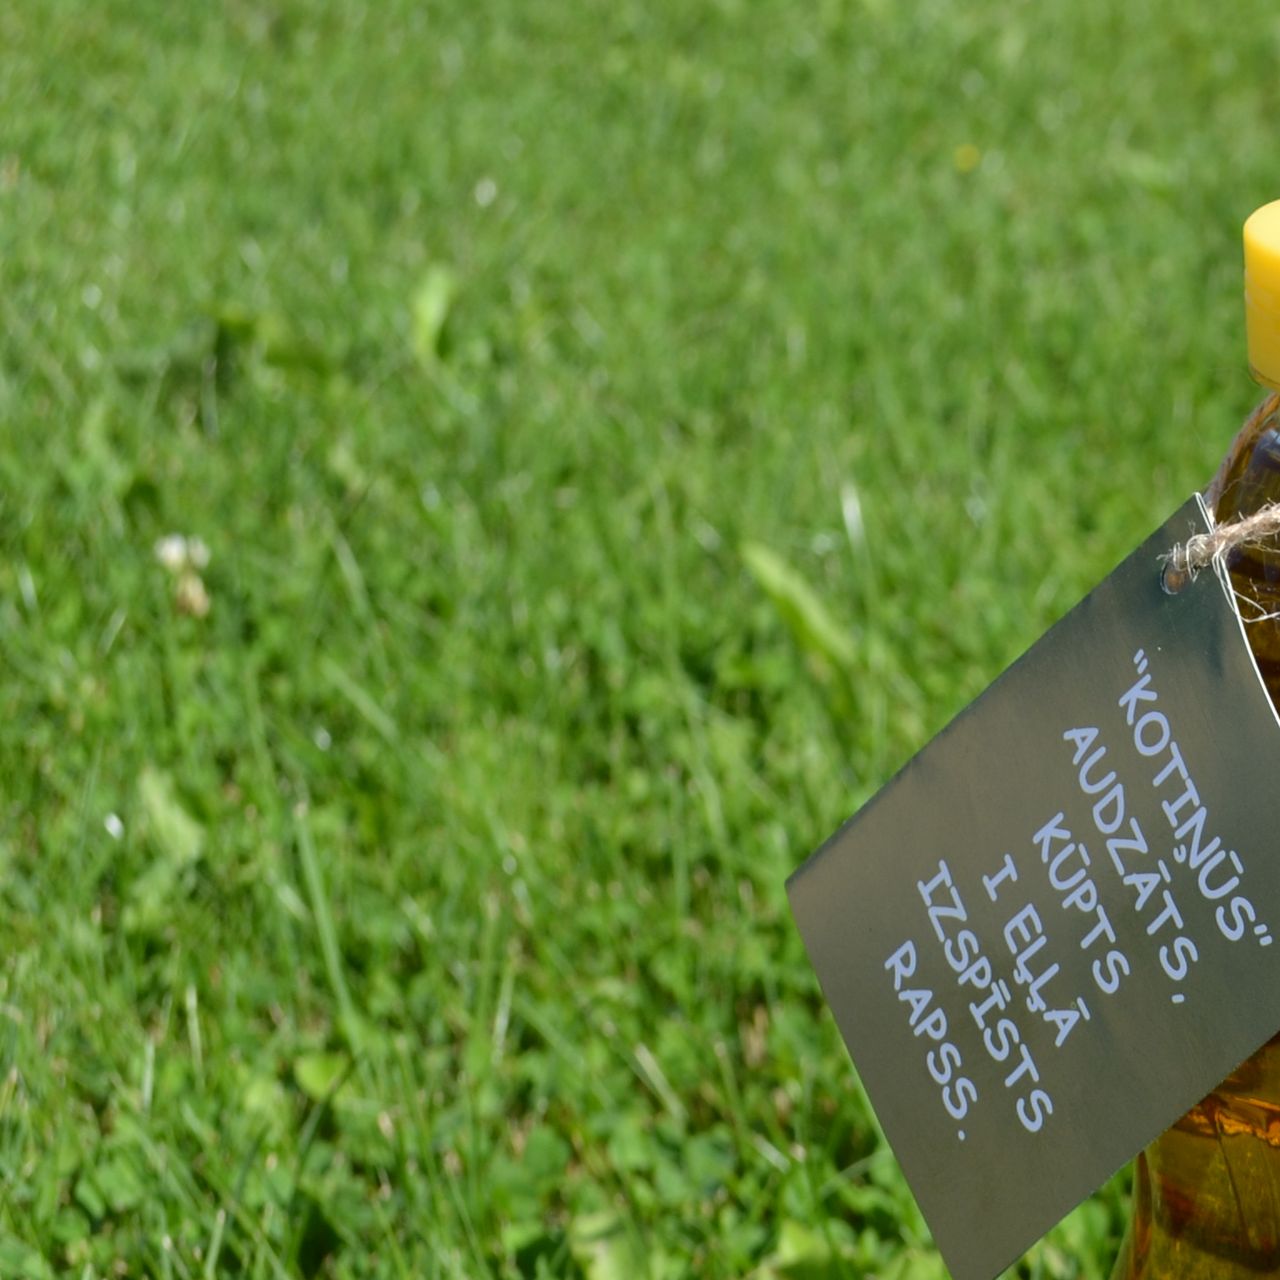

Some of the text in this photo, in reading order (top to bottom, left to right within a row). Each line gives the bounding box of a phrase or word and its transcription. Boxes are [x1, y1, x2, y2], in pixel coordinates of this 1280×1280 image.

[917, 859, 1054, 1133] IZSPĪSTS
[982, 853, 1091, 1048] I EĻĻĀ
[1032, 811, 1131, 995] KŪPTS
[884, 940, 978, 1141] RAPSS.
